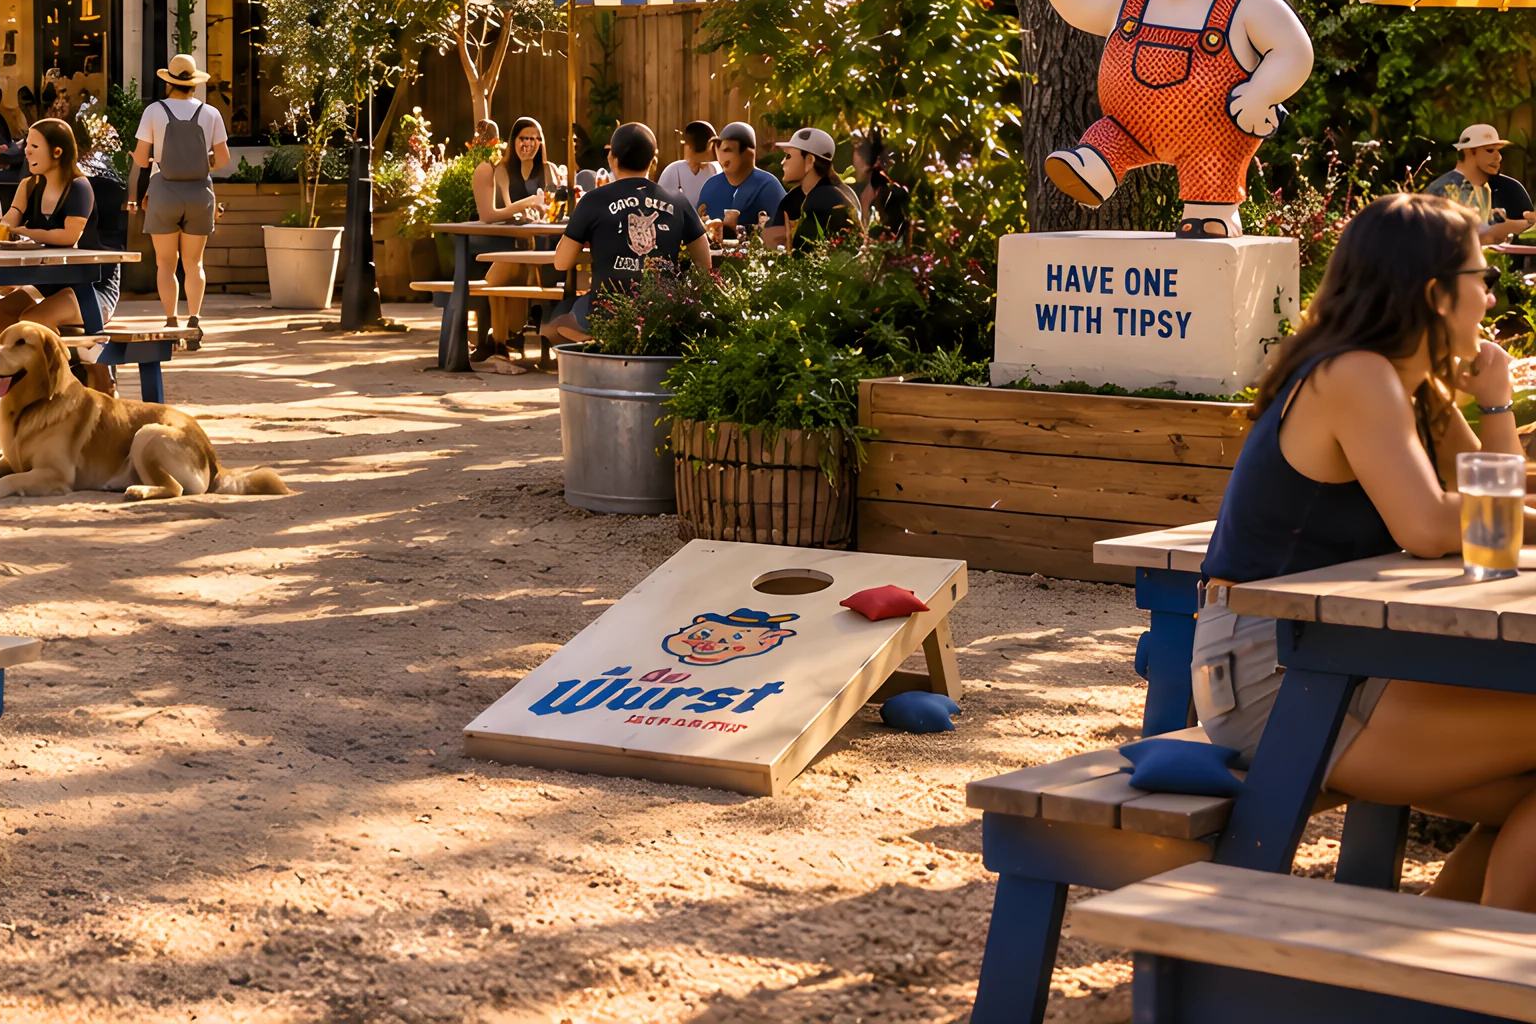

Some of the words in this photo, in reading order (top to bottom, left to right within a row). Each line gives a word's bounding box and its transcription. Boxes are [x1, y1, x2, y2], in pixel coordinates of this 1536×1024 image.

[1047, 264, 1114, 294] HAVE
[1124, 268, 1178, 297] ONE
[1035, 303, 1102, 334] WITH
[1114, 308, 1192, 339] TIPSY
